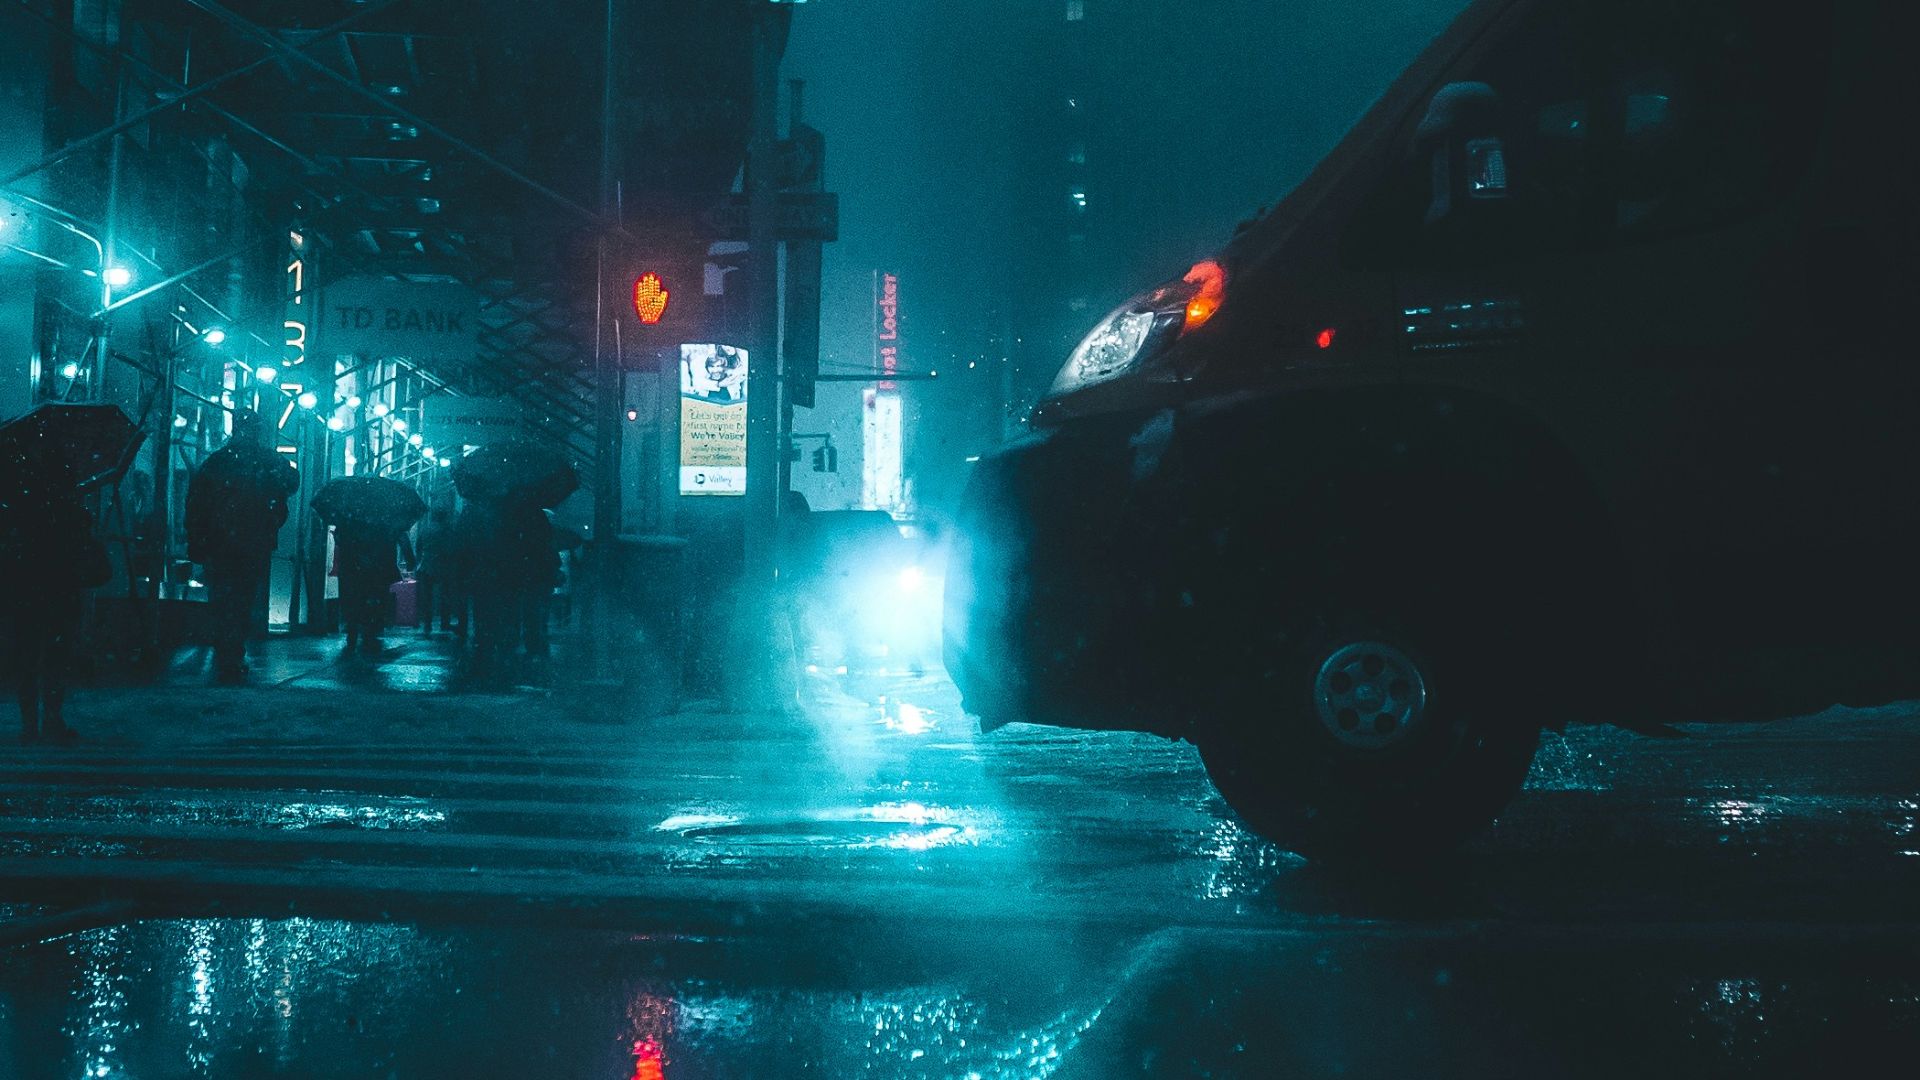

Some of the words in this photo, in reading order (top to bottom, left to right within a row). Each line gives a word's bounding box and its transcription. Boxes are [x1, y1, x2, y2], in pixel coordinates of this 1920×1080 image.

[879, 273, 897, 340] Locker
[334, 305, 374, 329] TD
[384, 307, 464, 333] BANK
[690, 431, 716, 440] We're
[709, 475, 732, 485] Valley
